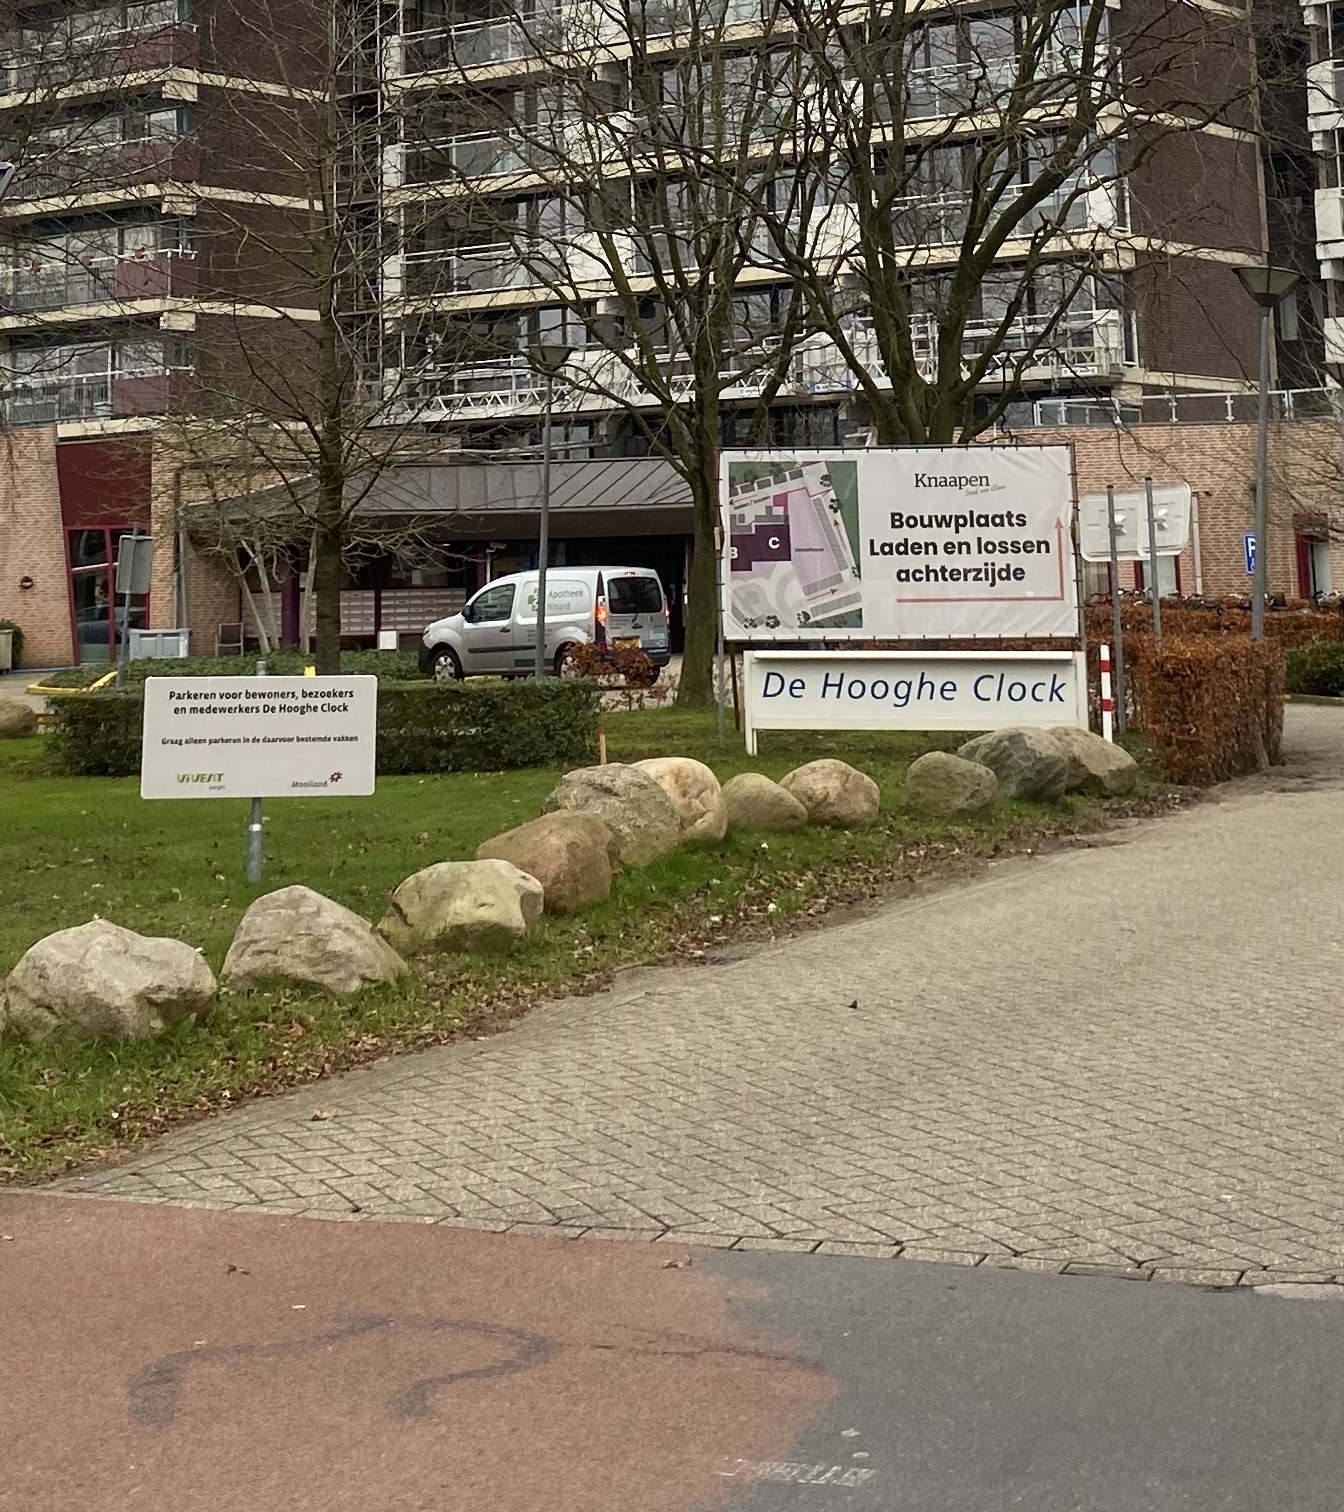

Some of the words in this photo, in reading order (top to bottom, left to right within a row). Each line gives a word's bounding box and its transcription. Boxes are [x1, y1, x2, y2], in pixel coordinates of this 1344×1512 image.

[914, 473, 990, 491] Knaapen
[890, 510, 1027, 534] Bouwplaats
[768, 536, 781, 550] C
[869, 537, 938, 556] Laden
[943, 540, 971, 555] en
[976, 536, 1051, 555] lossen
[896, 561, 1026, 588] achterzijde
[547, 589, 584, 600] Apotheek
[169, 690, 216, 701] Parkeren
[218, 691, 243, 700] voor
[244, 689, 299, 701] bewoners,
[301, 688, 354, 699] bezoekers
[762, 671, 806, 699] De
[821, 671, 957, 708] Hooghe
[973, 672, 1067, 703] Clock
[173, 706, 187, 715] en
[189, 704, 260, 715] medewerkers
[262, 704, 277, 714] De
[278, 703, 319, 716] Hooghe
[321, 702, 349, 713] Clock
[161, 737, 183, 747] Graag
[208, 737, 242, 746] parkeren
[251, 736, 261, 744] de
